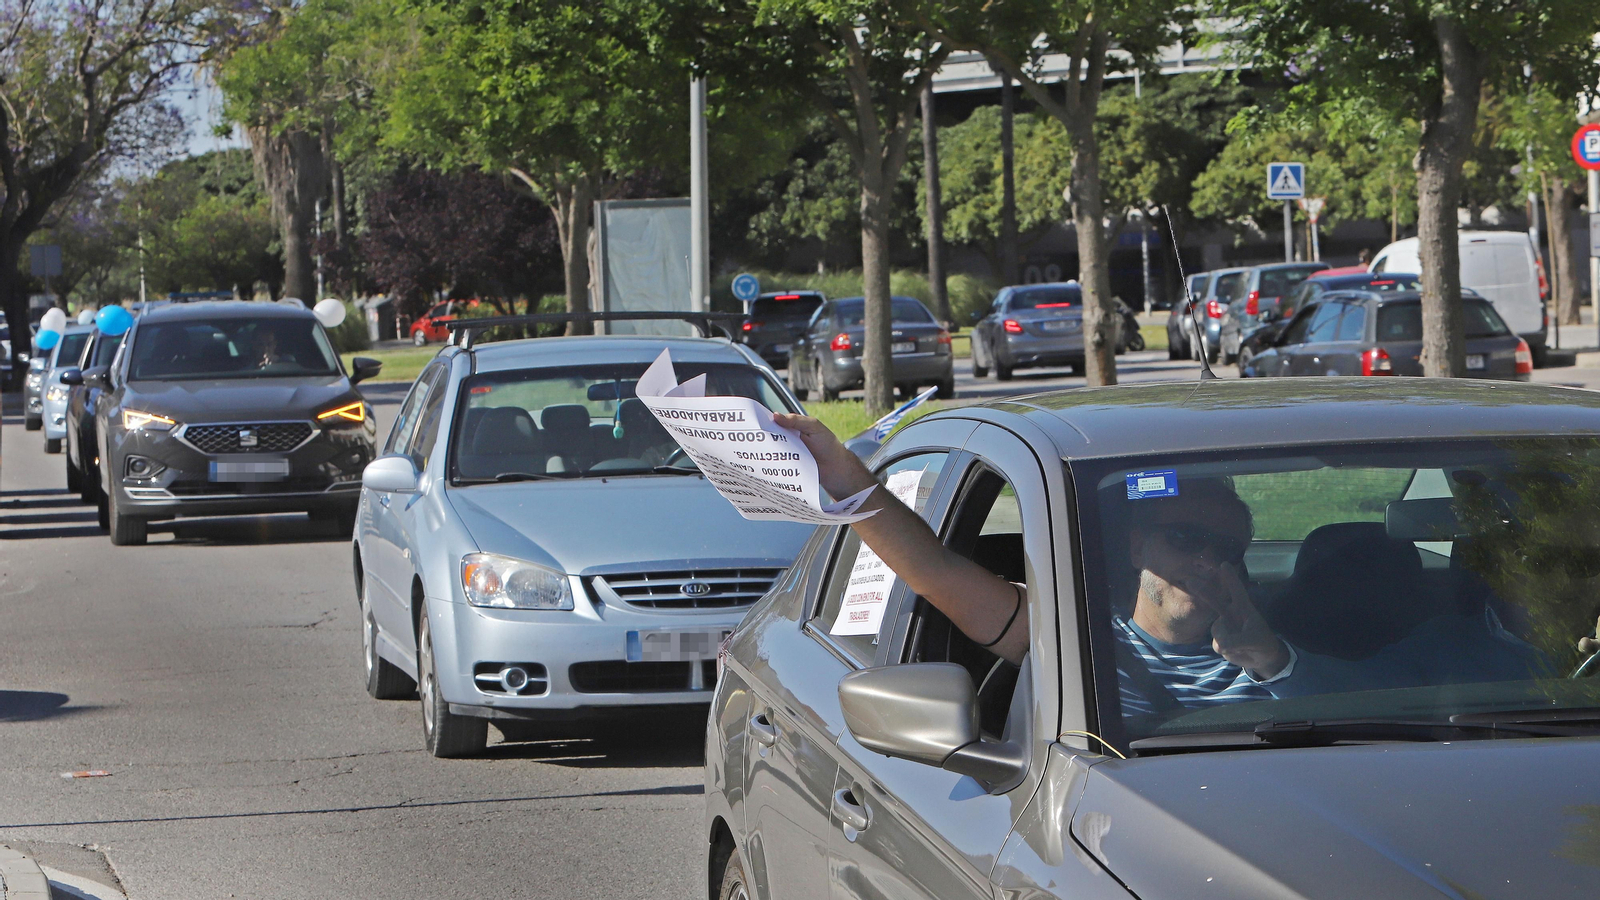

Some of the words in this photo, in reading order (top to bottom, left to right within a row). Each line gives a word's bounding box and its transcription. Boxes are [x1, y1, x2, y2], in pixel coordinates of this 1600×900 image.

[1590, 138, 1598, 149] P
[728, 431, 766, 443] GOOD
[733, 450, 800, 461] DIRECTIVOS.
[761, 467, 801, 477] 100.000
[685, 584, 706, 593] KIA
